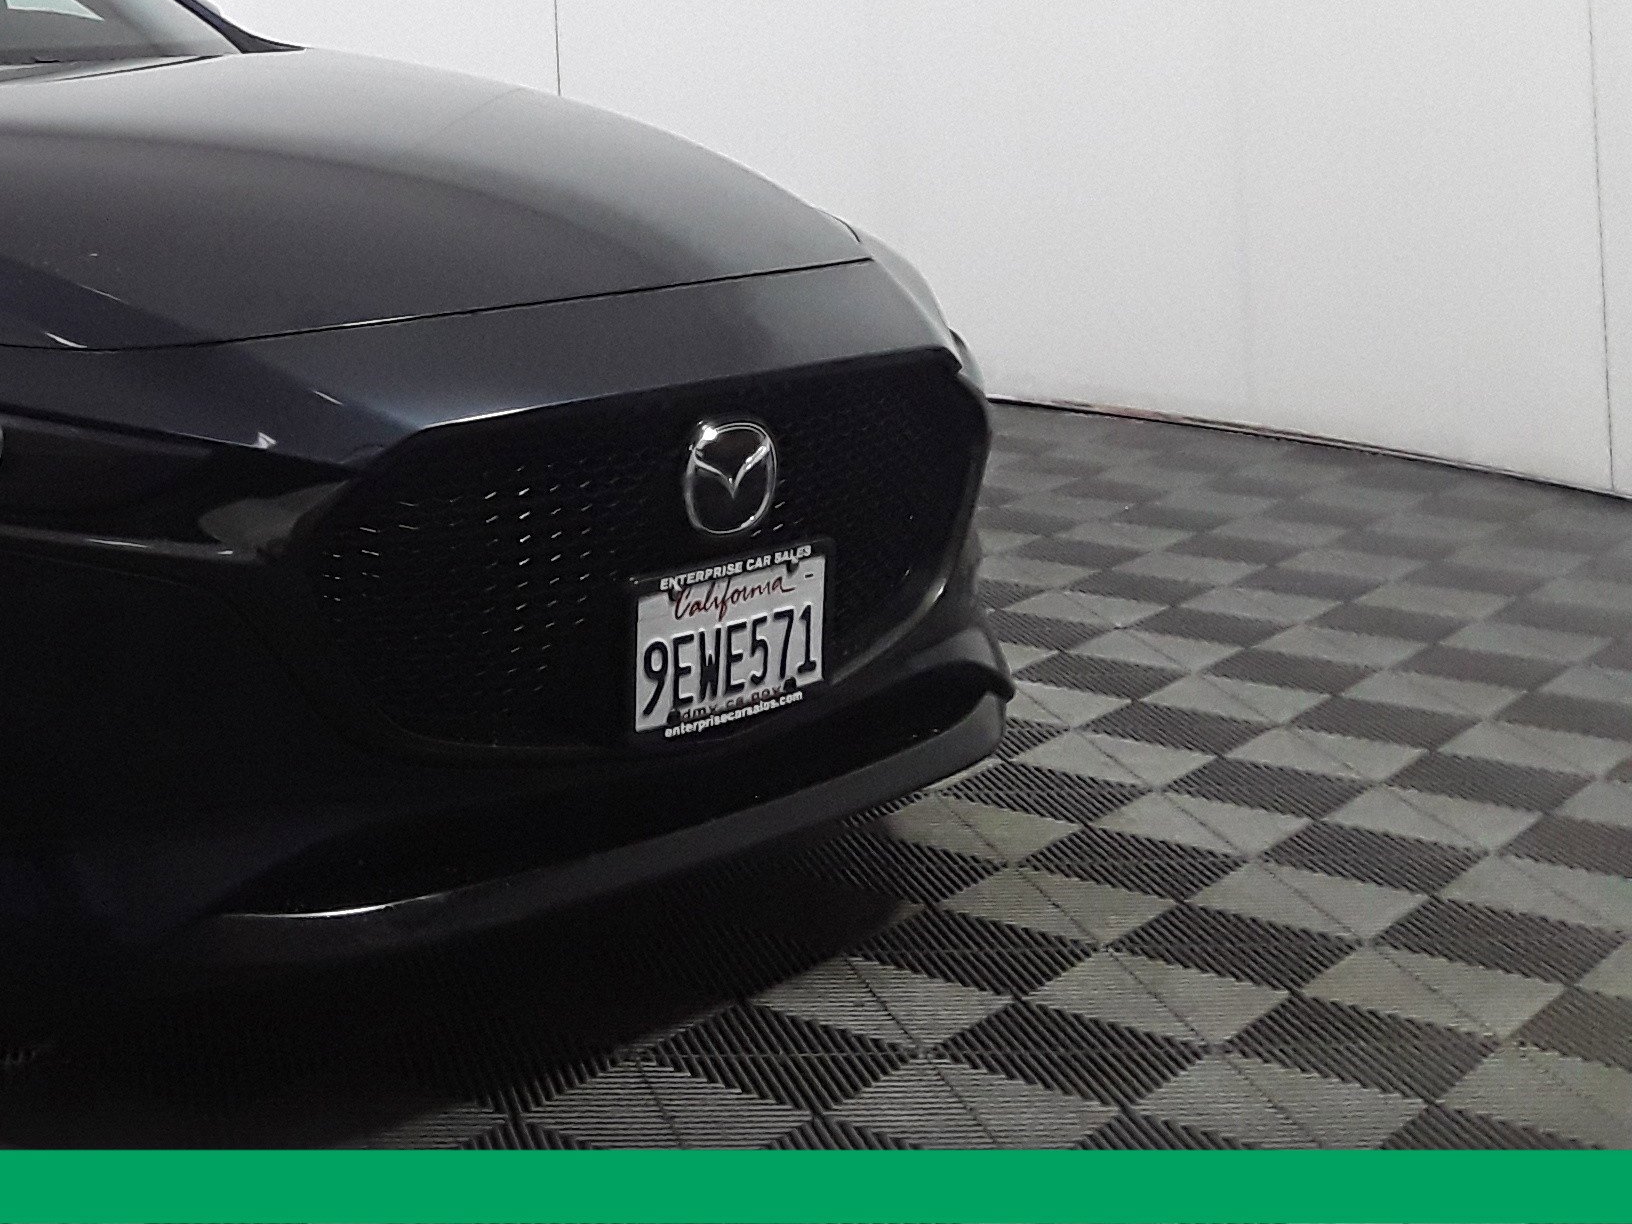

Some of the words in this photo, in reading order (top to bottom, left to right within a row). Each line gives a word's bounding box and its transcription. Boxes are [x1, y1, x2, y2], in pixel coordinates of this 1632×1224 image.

[660, 561, 744, 591] ENTERPRISE
[746, 555, 771, 571] CAR
[774, 544, 813, 564] SALES
[674, 576, 796, 622] California
[642, 603, 818, 717] 9EWE571
[680, 685, 782, 722] dmvcagov
